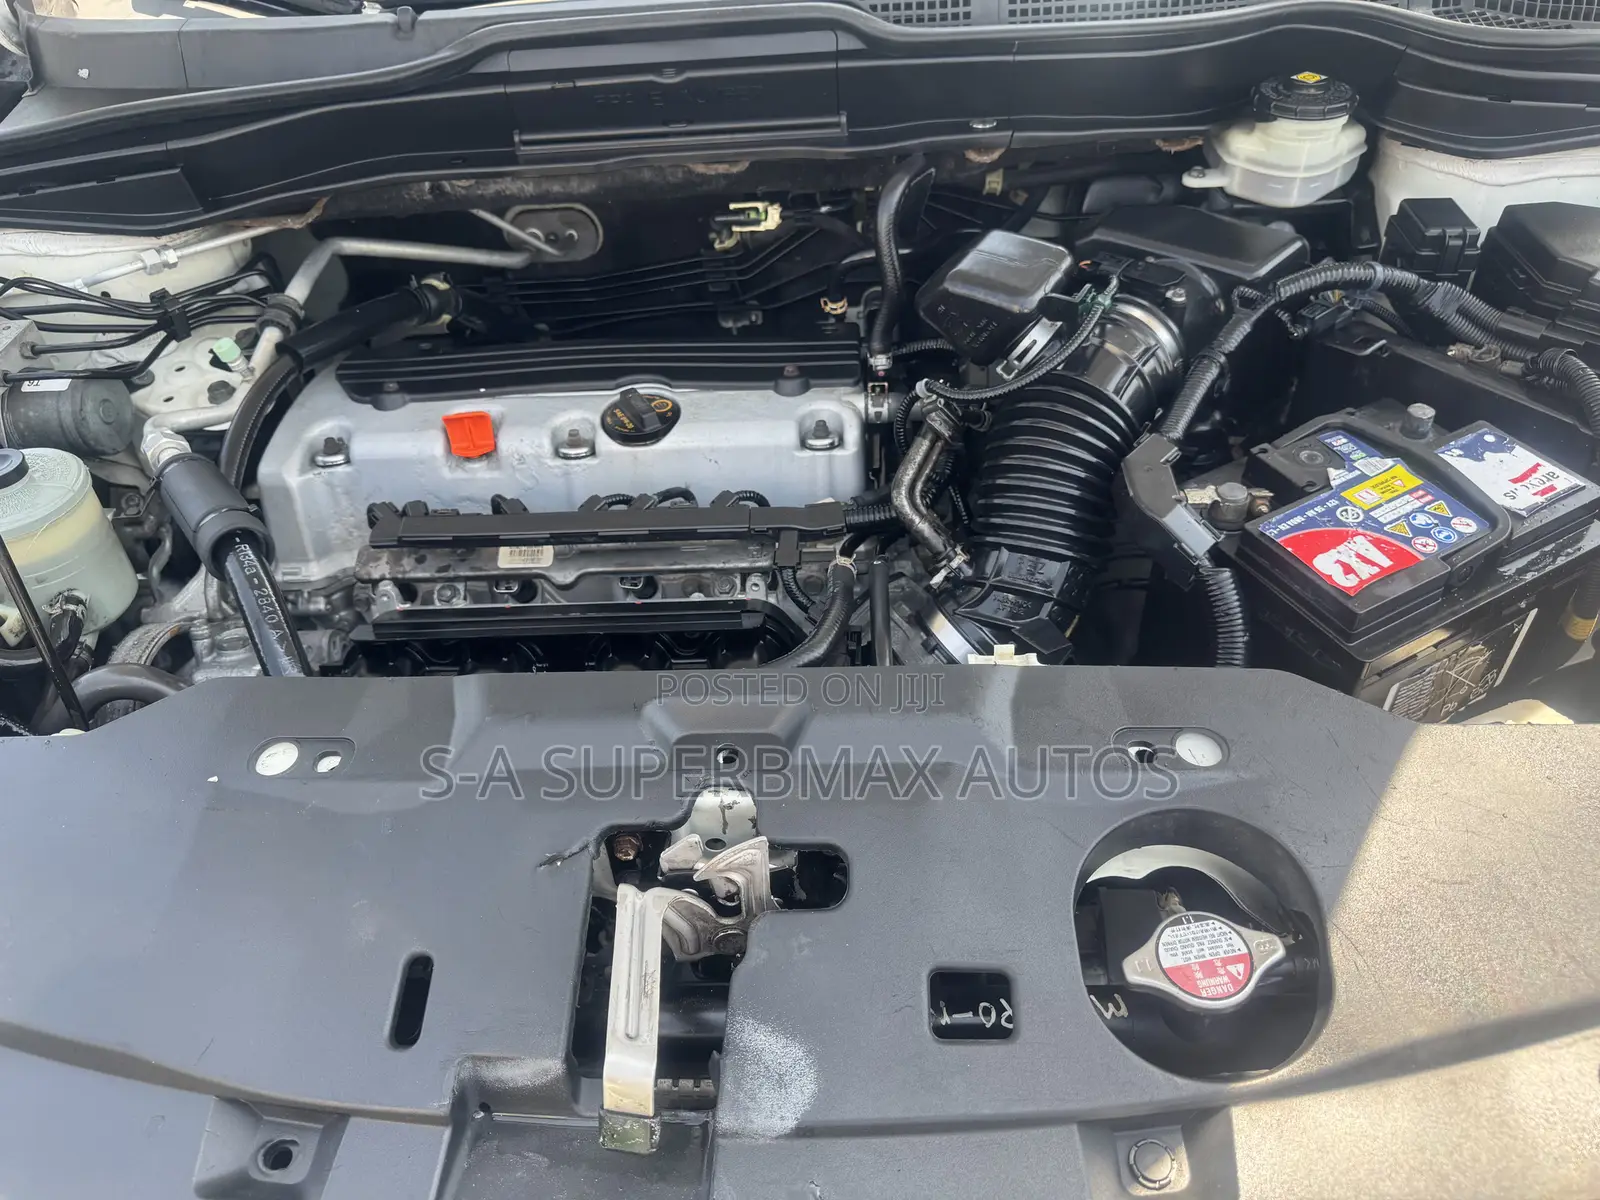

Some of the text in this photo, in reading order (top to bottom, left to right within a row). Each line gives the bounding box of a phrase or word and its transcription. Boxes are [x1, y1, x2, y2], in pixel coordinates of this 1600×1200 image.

[235, 543, 257, 575] R134a
[253, 588, 280, 624] 2840
[1181, 913, 1194, 924] 1.1
[1199, 983, 1234, 997] DANGER
